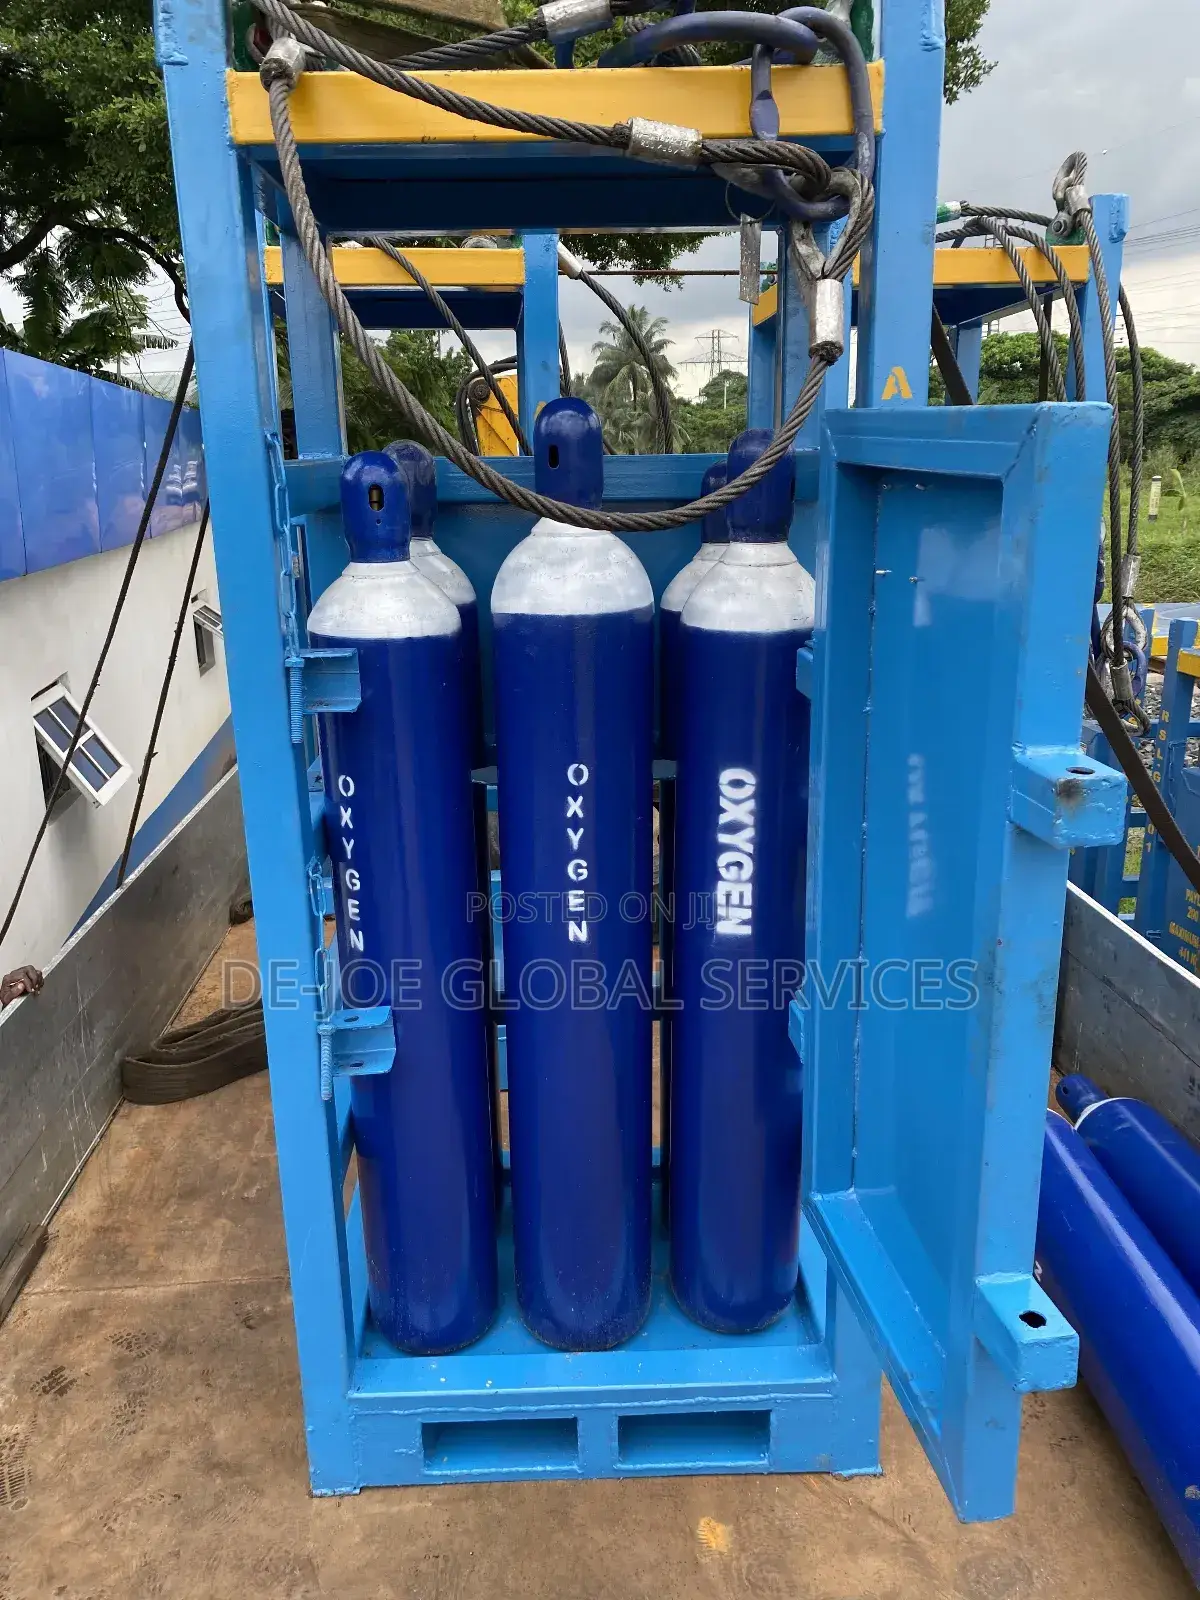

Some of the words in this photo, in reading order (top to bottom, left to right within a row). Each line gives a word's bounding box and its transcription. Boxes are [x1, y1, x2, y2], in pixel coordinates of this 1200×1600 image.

[881, 366, 913, 400] A
[338, 774, 365, 952] OXYGEN
[566, 763, 589, 942] OXYGEN
[715, 767, 757, 936] OXYGEN
